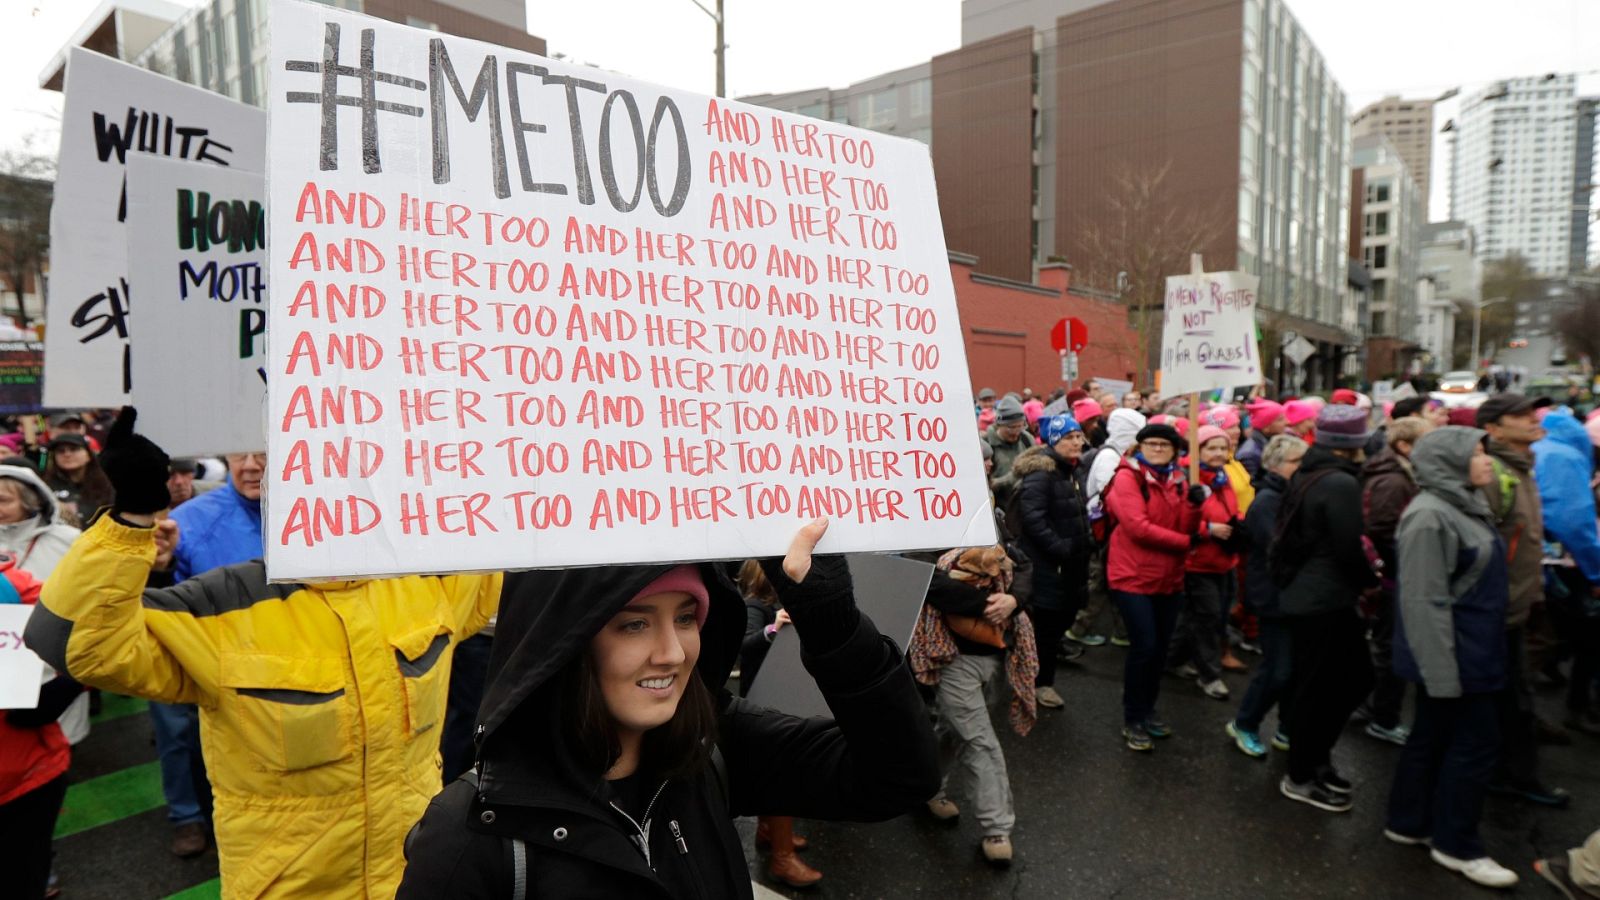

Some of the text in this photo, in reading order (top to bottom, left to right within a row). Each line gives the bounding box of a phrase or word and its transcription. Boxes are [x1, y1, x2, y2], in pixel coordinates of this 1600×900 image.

[703, 99, 874, 168] AND HER TOO
[709, 151, 888, 212] AND HER TOO
[296, 182, 928, 296] AND HER TOO AND HER TOO AND HER TOO
[710, 193, 897, 250] AND HER TOO
[288, 232, 936, 335] AND HER TOO AND HER TOO AND HER TOO
[288, 280, 939, 370] AND HER TOO AND HER TOO AND HER TOO
[1184, 310, 1215, 328] NOT
[286, 331, 943, 404] AND HER TOO AND HER TOO AND HER TOO
[282, 385, 947, 442] AND HER TOO AND HER TOO AND HER TOO
[282, 436, 956, 486] AND HER TOO AND HER TOO AND HER TOO
[281, 482, 962, 547] AND HER TOO AND HER TOO AND HER TOO
